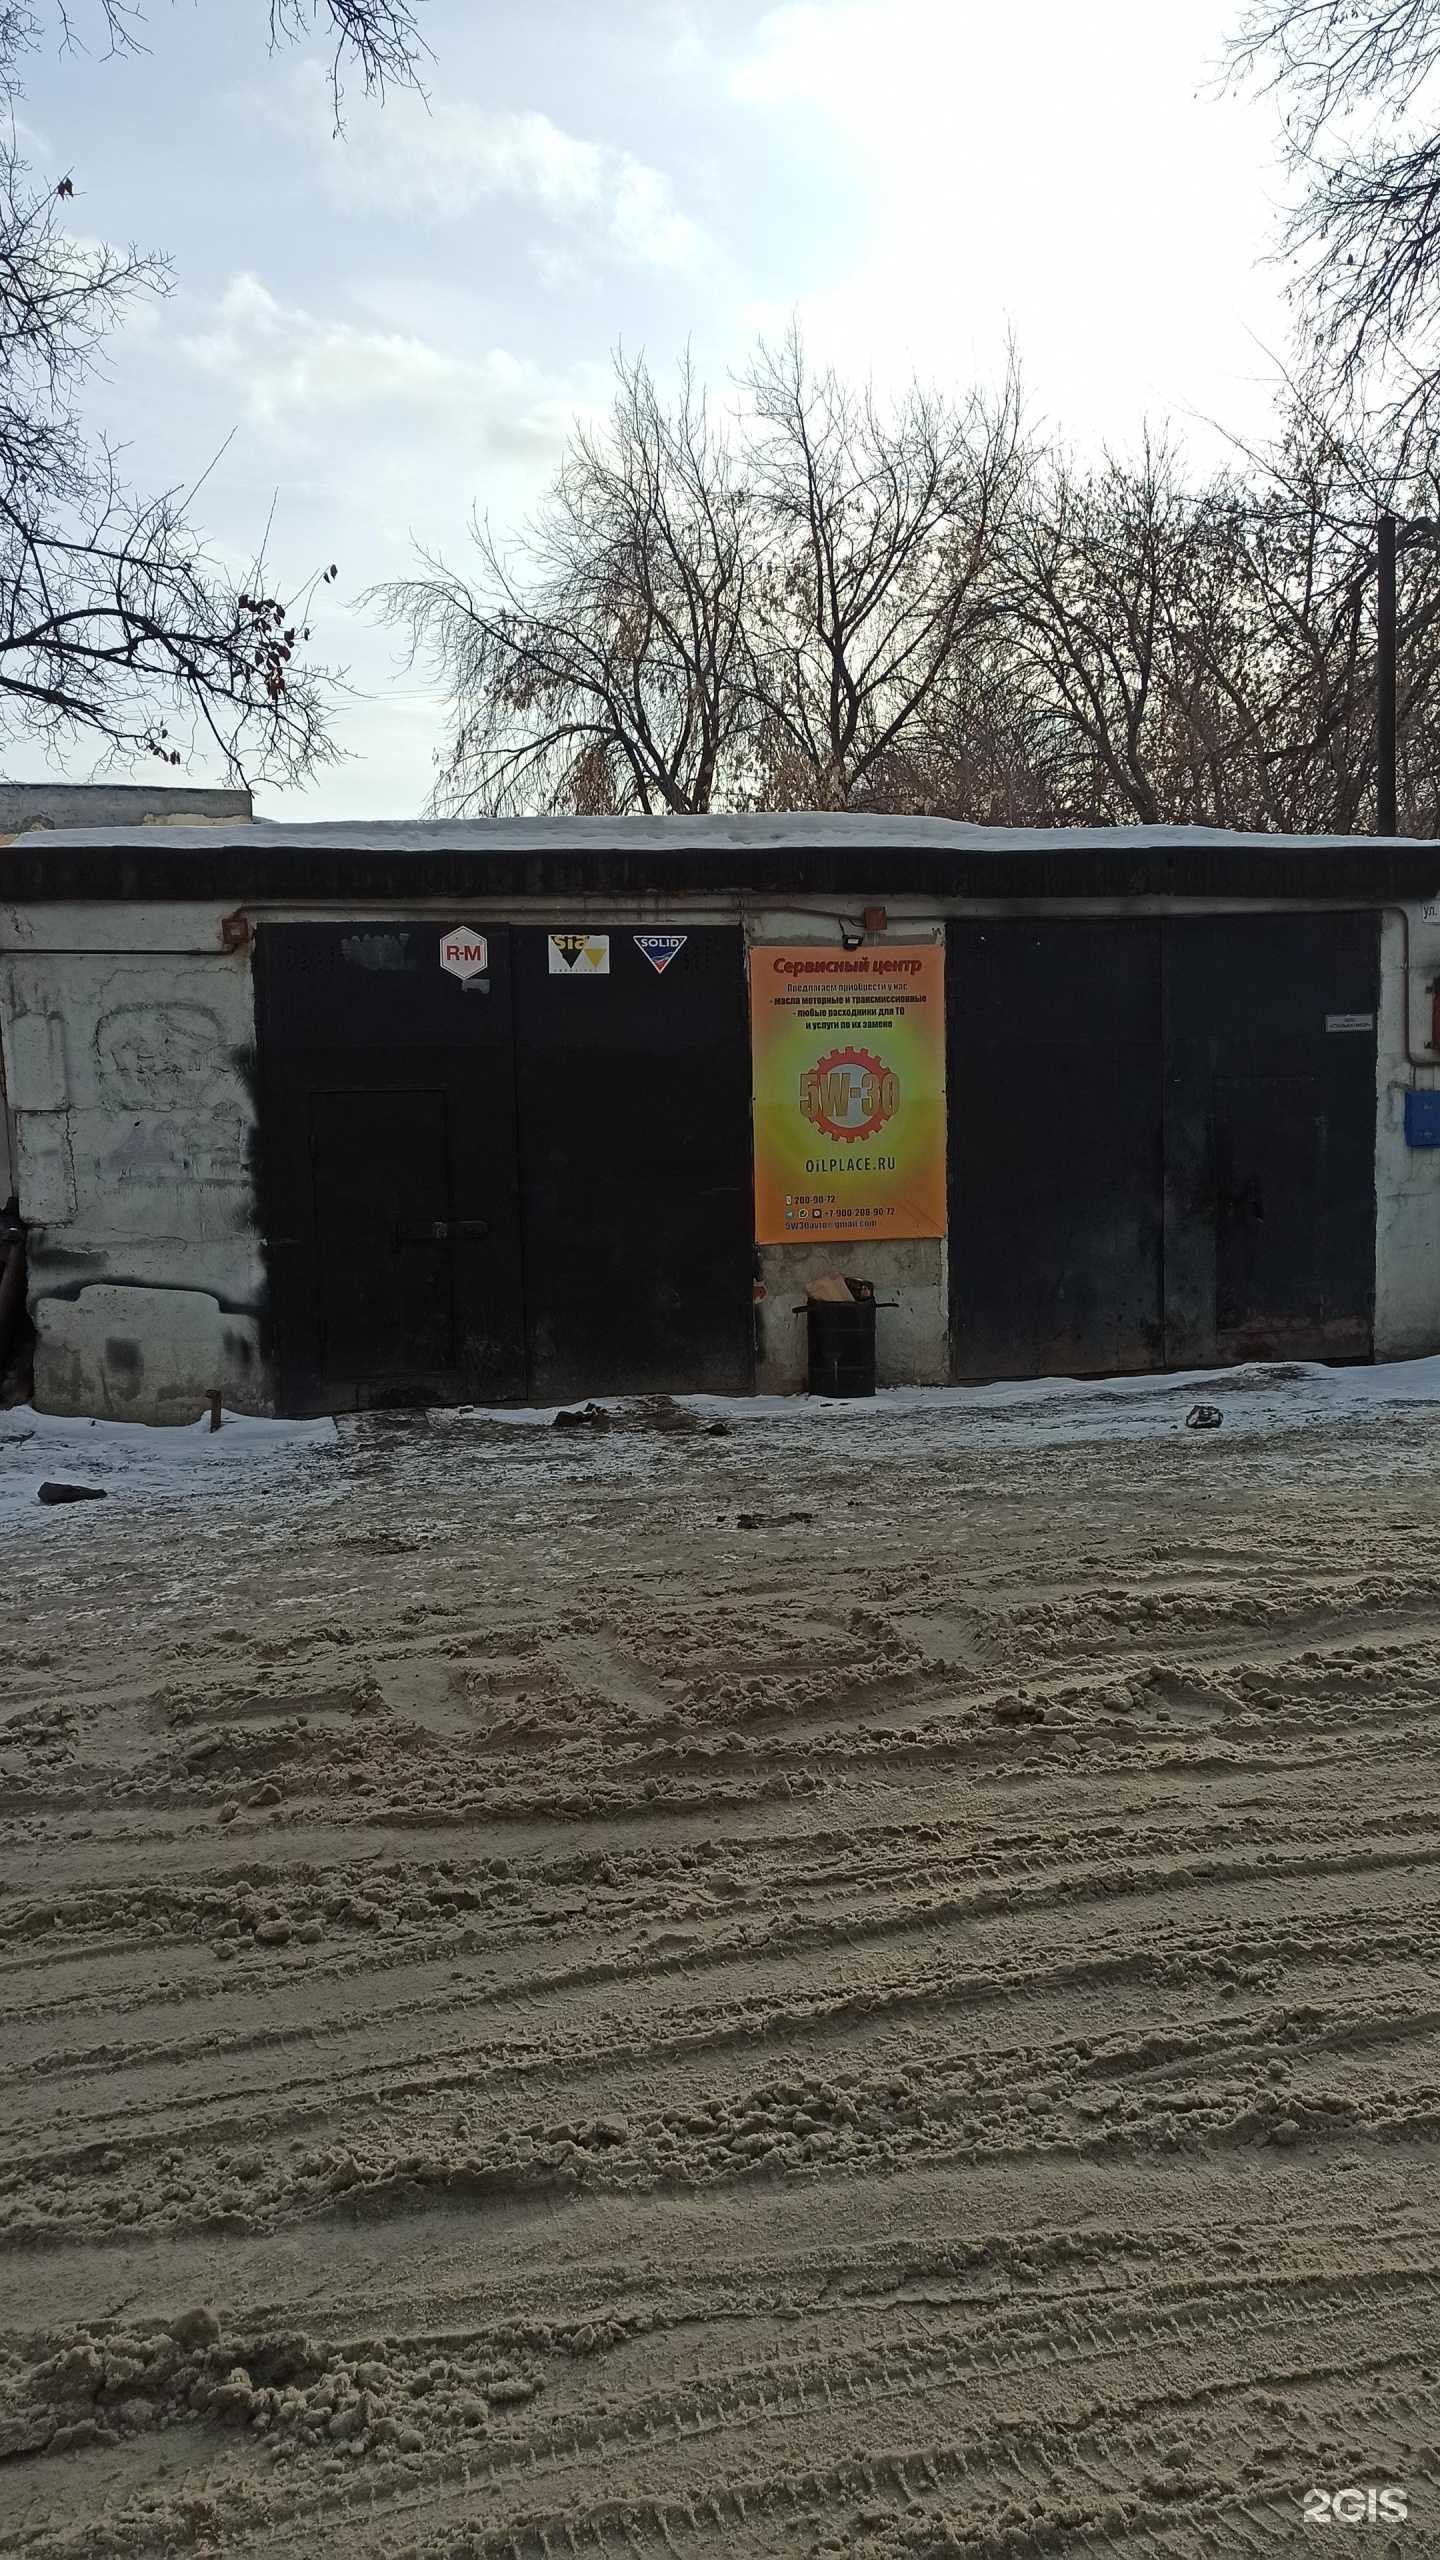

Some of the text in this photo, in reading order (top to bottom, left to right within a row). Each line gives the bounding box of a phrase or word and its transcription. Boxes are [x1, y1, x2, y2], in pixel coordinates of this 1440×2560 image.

[641, 937, 680, 948] SOLID
[446, 945, 482, 961] R-M
[773, 956, 922, 977] Сервисный центр
[787, 983, 838, 993] Предлагаем
[838, 983, 887, 993] приобрести
[774, 996, 800, 1006] масла
[802, 995, 844, 1005] моторные
[851, 995, 927, 1004] трансмиссионные
[797, 1007, 827, 1017] любые
[828, 1008, 877, 1017] расходники
[878, 1007, 894, 1017] для
[895, 1006, 905, 1016] ТО
[806, 1022, 811, 1030] и
[813, 1021, 839, 1030] услуги
[840, 1021, 850, 1030] по
[852, 1021, 862, 1029] их
[800, 1072, 899, 1117] 5W-30
